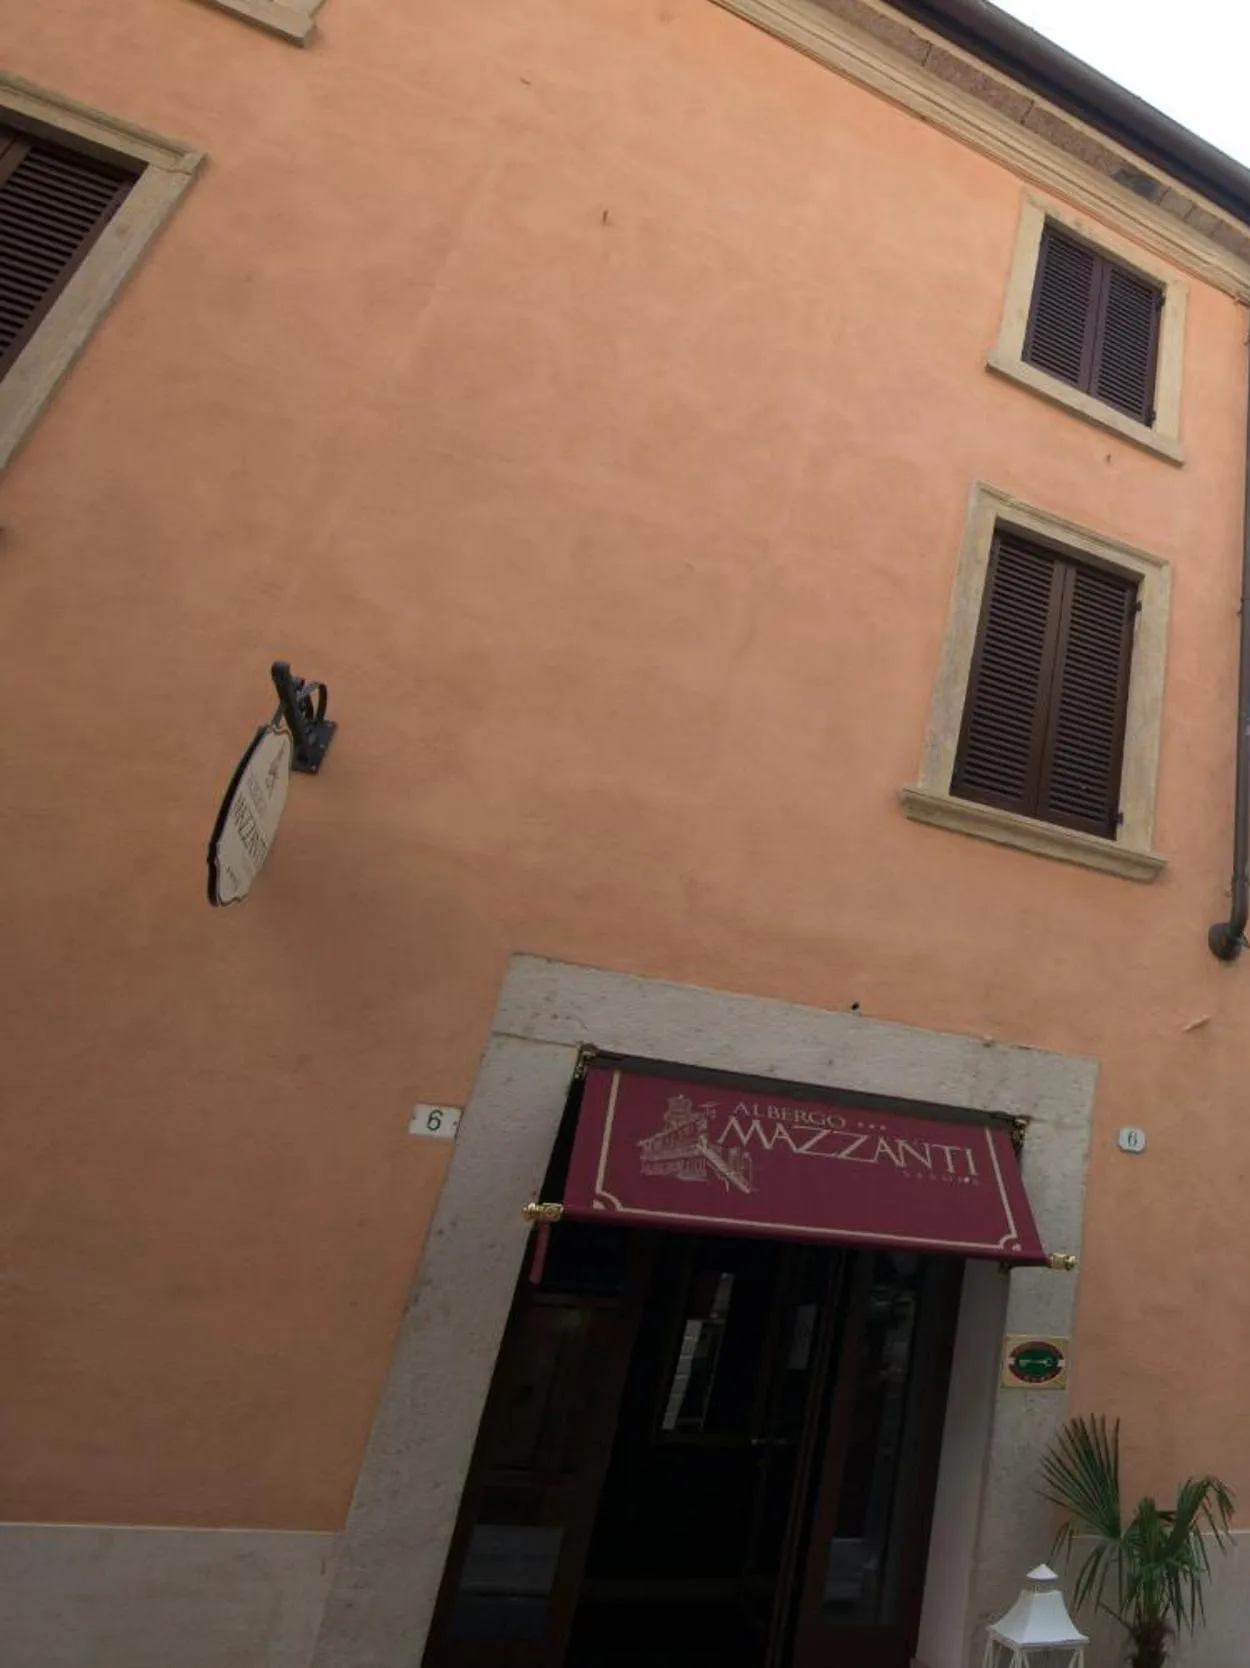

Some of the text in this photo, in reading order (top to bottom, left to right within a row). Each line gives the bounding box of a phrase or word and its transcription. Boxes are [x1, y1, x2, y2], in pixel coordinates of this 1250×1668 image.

[427, 1109, 443, 1131] 6
[733, 1101, 847, 1129] ALBERGO
[717, 1115, 979, 1176] MAZZANTI
